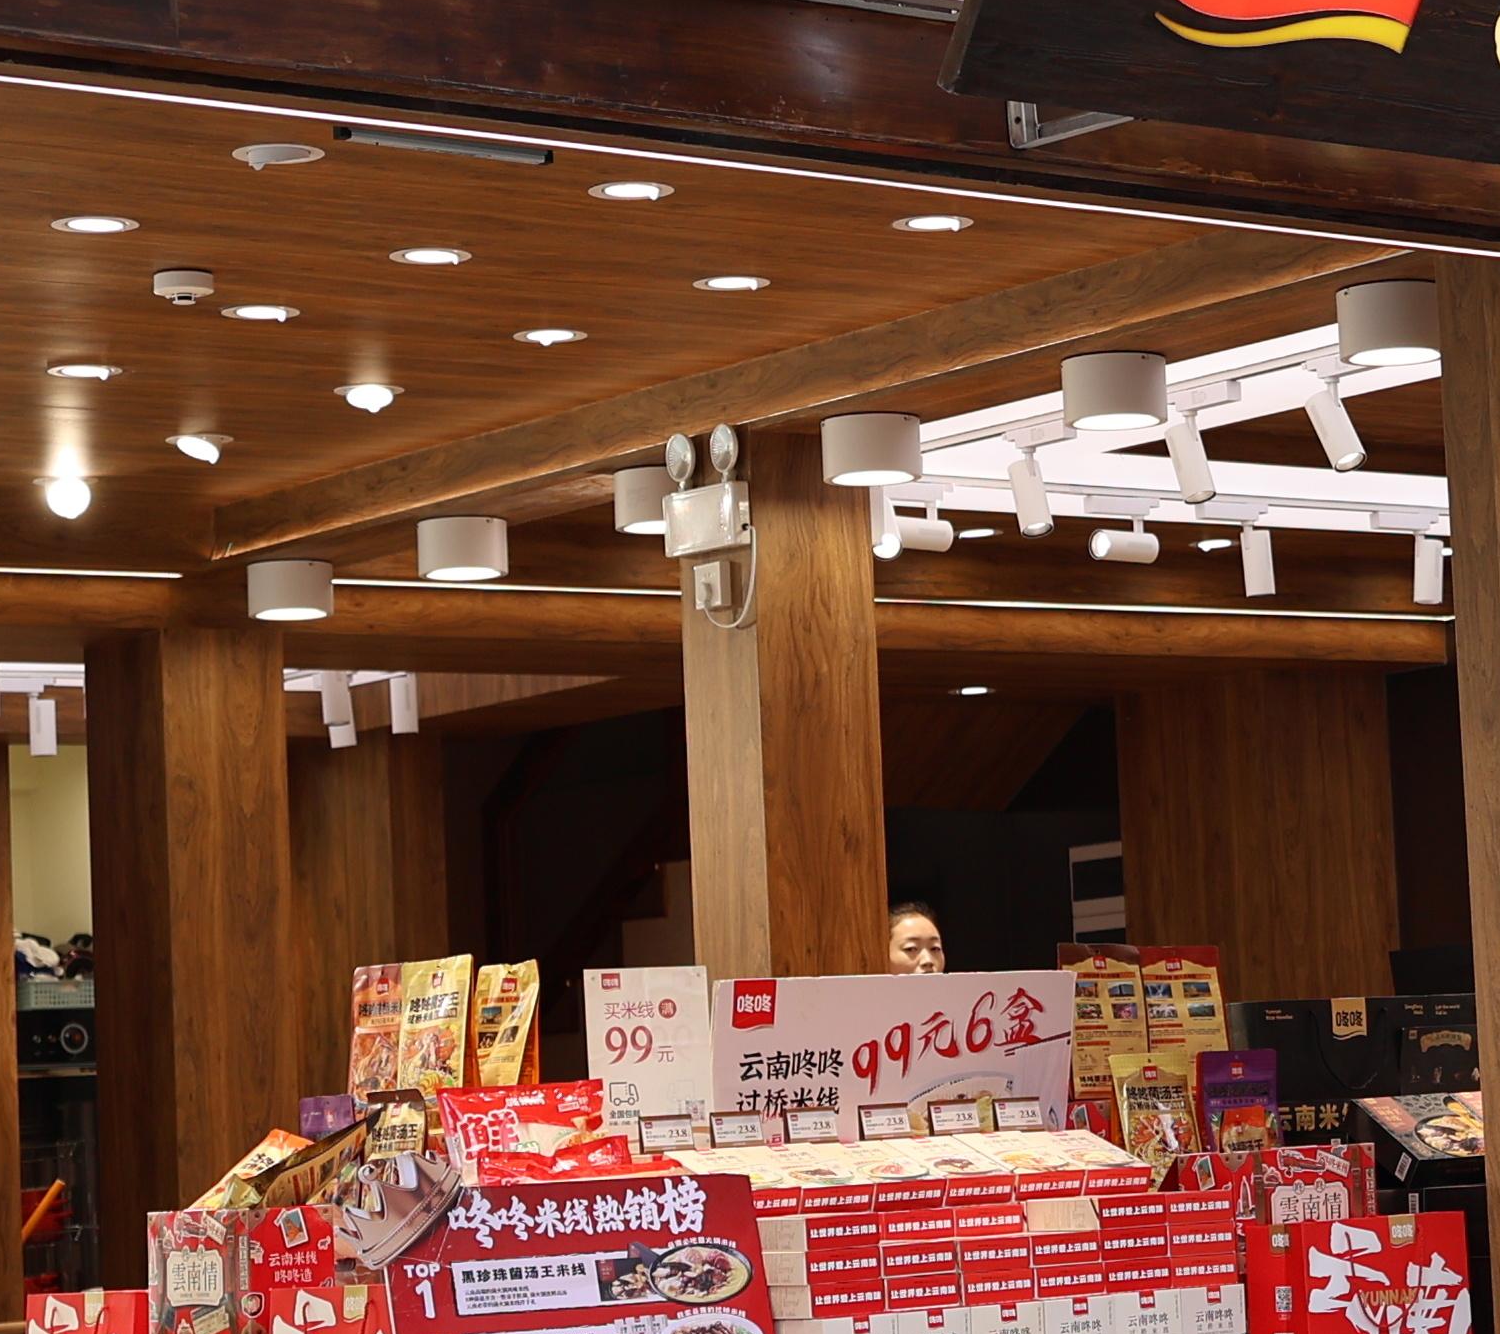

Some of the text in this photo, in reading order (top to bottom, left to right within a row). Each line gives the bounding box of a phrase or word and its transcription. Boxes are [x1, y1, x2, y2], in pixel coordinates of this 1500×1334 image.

[603, 1001, 655, 1020] 买米线
[737, 993, 772, 1014] 咚咚
[1335, 1011, 1364, 1027] 咚咚
[604, 1025, 675, 1064] 99 元
[852, 987, 1044, 1096] 99元6盒
[739, 1048, 844, 1081] 云南咚咚
[1277, 1102, 1350, 1131] 云南米
[448, 1176, 707, 1249] 咚咚米线热销榜
[268, 1250, 318, 1267] 云南米线
[403, 1262, 441, 1279] TOP
[461, 1262, 587, 1284] 黑珍珠菌汤王米线
[415, 1279, 437, 1320] 1
[1127, 1312, 1169, 1328] 云南咚咚
[1195, 1308, 1234, 1323] 云南咚咚
[1060, 1319, 1102, 1334] 云南咚咚
